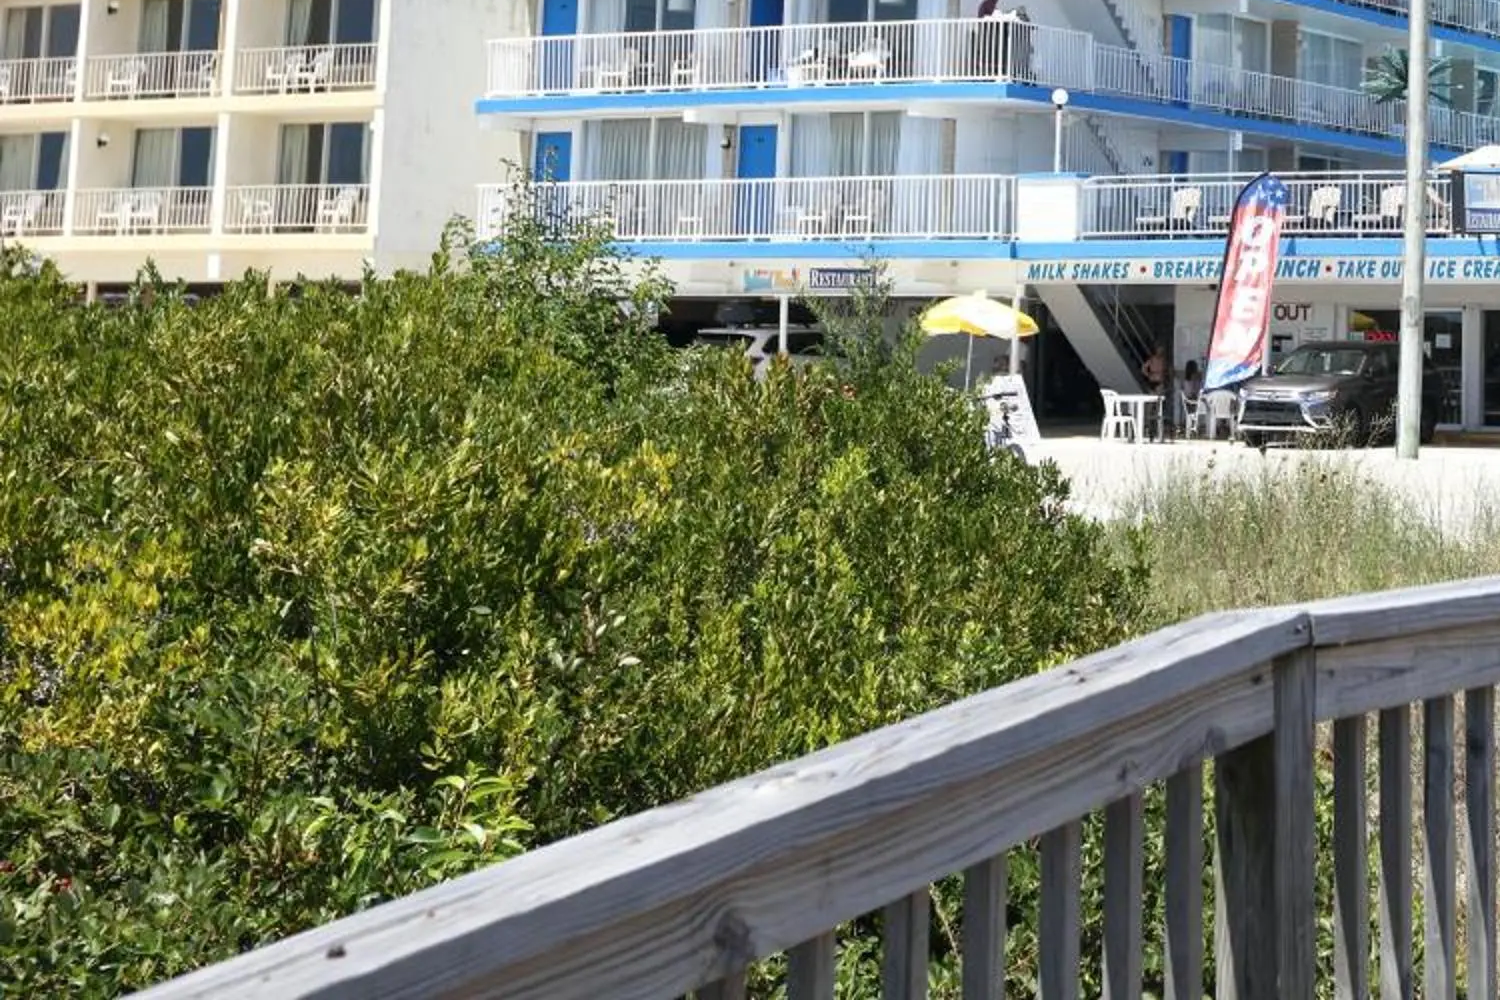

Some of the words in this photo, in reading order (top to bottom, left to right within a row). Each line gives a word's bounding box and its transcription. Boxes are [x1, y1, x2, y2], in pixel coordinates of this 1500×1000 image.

[1027, 261, 1067, 279] MILK
[1071, 261, 1130, 279] SHAKES
[1153, 260, 1223, 279] BREAKFA
[1274, 260, 1321, 279] NCH
[1337, 260, 1375, 279] TAKE
[1381, 260, 1402, 279] OU
[1429, 260, 1457, 279] ICE
[1274, 303, 1312, 321] OUT
